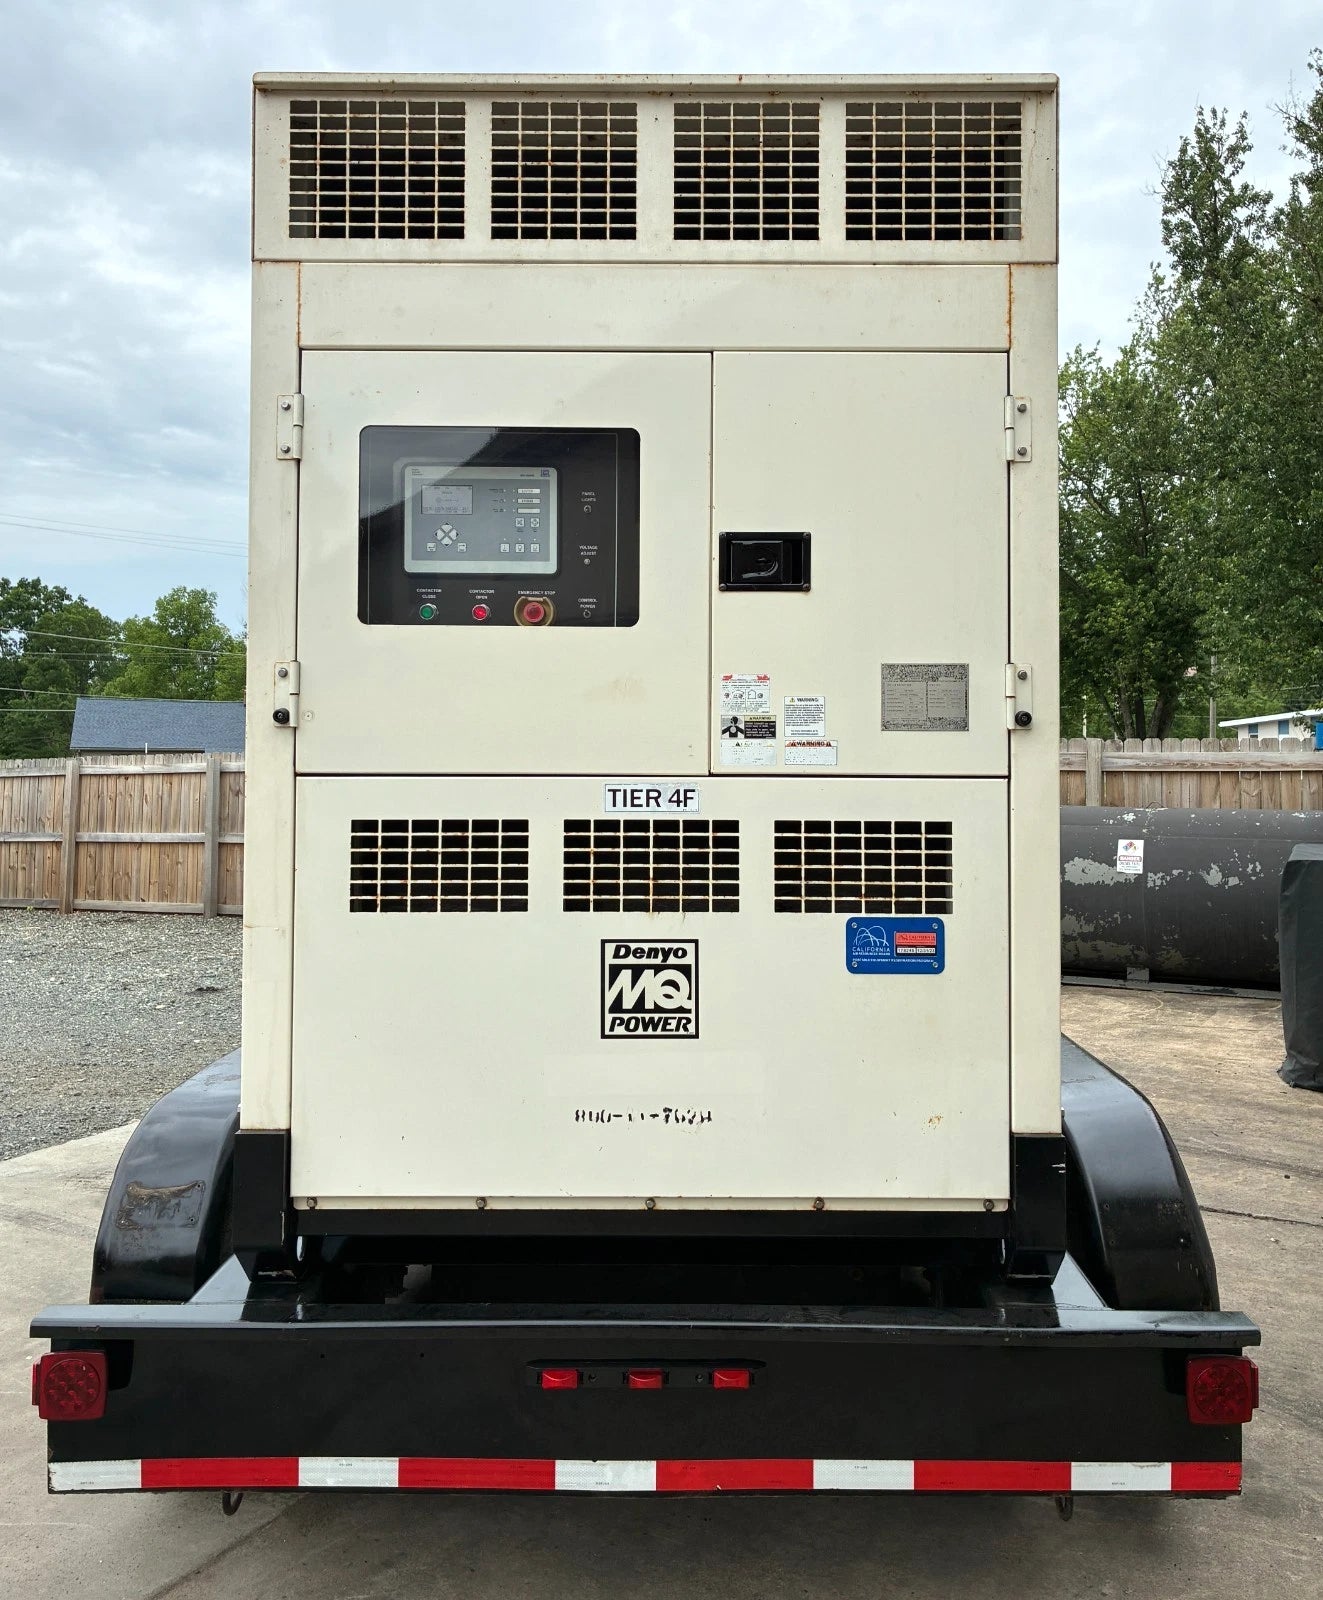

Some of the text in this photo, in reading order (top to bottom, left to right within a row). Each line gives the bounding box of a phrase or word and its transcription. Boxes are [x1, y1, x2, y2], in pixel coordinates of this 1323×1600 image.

[607, 788, 696, 808] TIER 4F
[612, 944, 688, 963] Denyo
[608, 969, 692, 1009] MQ
[609, 1016, 692, 1032] POWER
